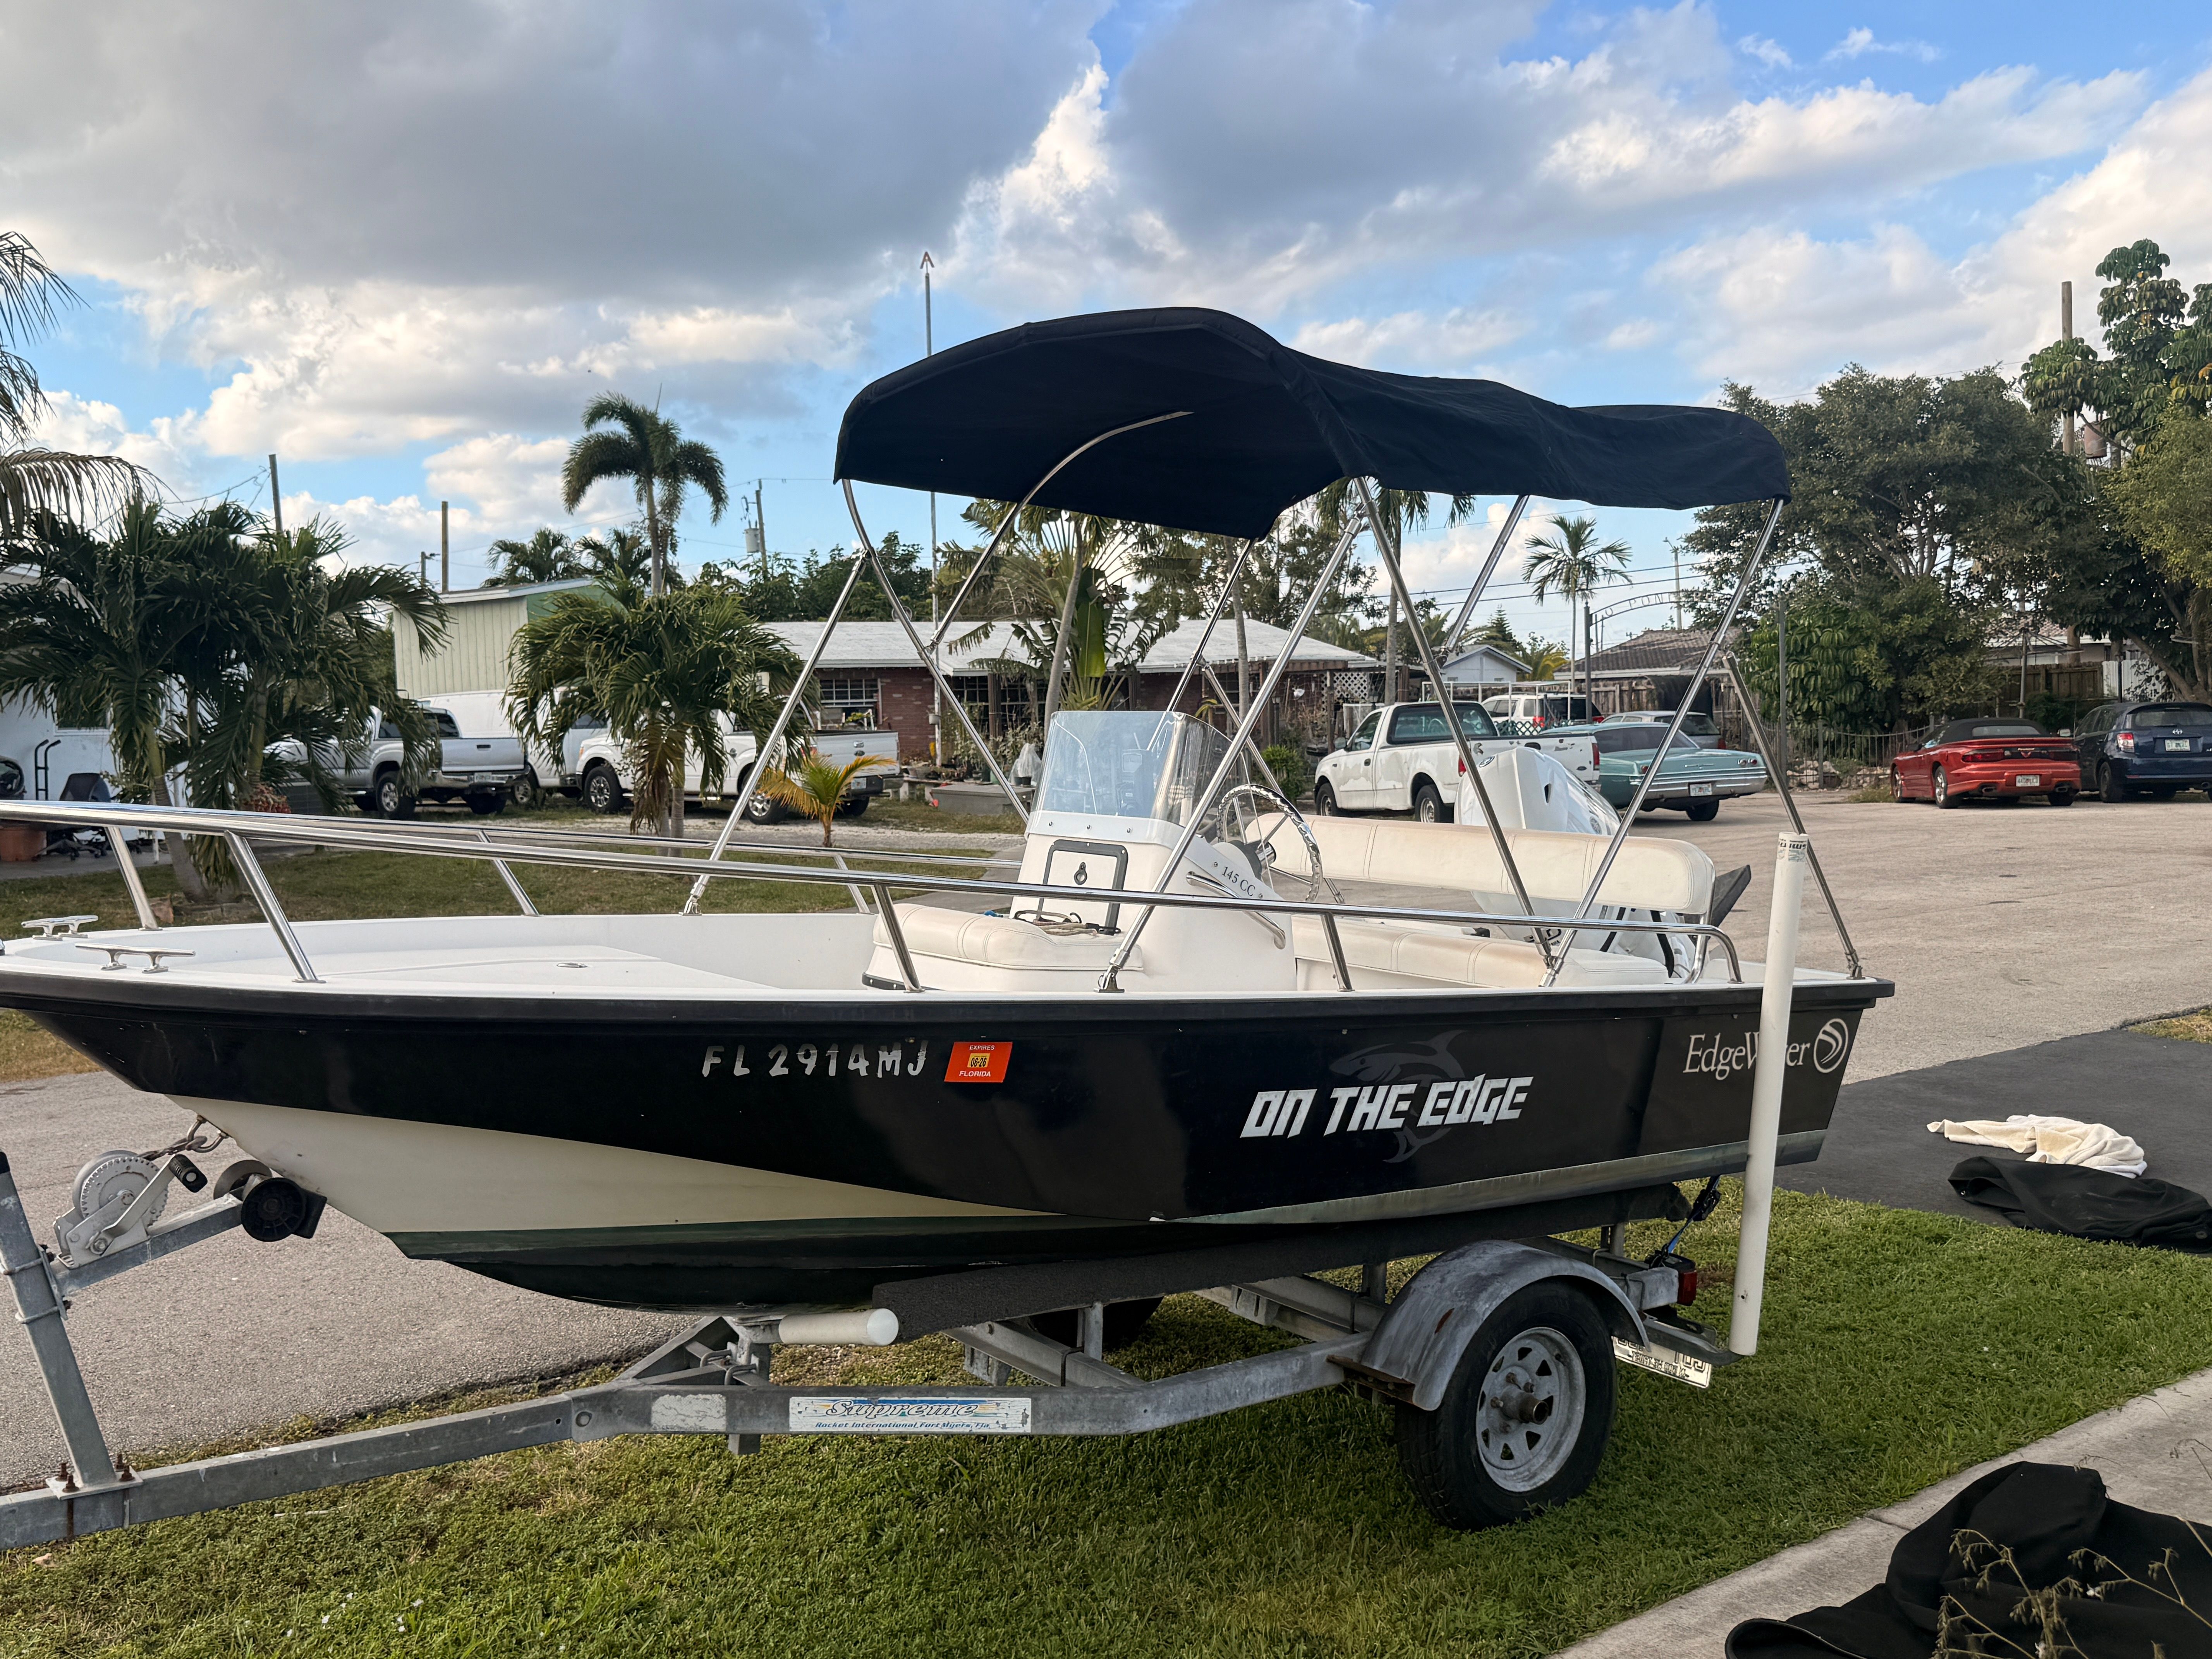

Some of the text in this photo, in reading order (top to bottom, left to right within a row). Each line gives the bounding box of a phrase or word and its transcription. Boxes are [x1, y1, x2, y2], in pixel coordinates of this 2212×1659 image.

[1222, 866, 1255, 896] 145 CC
[1683, 1032, 1810, 1081] EdgeWer
[1323, 1084, 1418, 1137] THE
[1417, 1073, 1534, 1127] EDGE
[826, 1400, 978, 1419] Supreme
